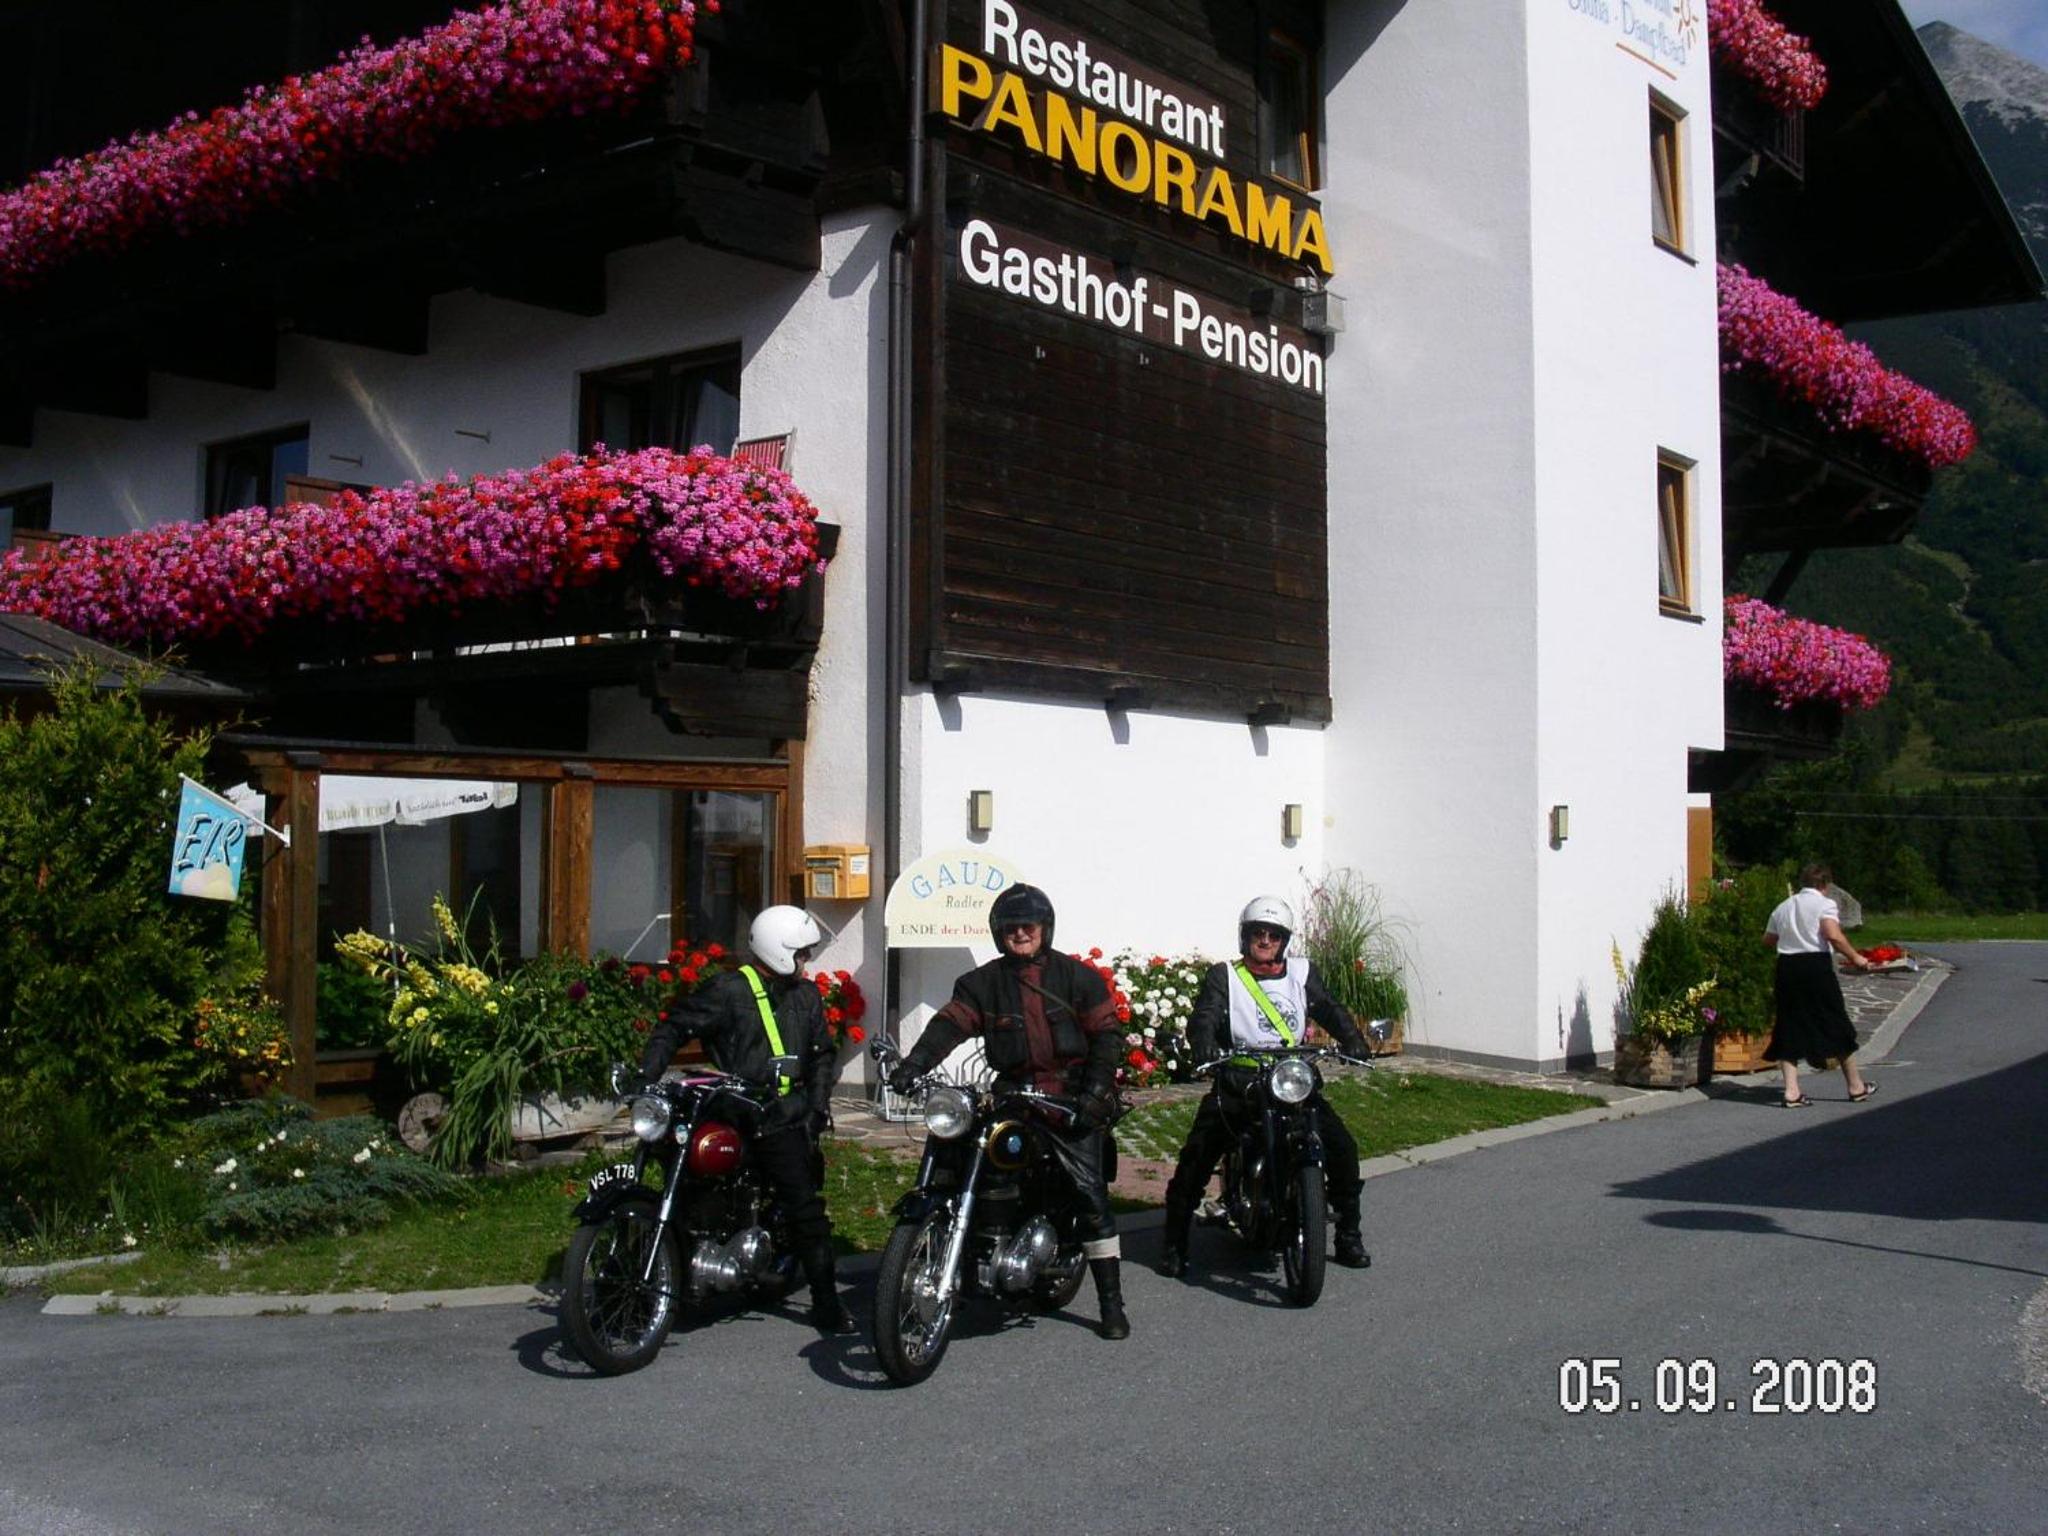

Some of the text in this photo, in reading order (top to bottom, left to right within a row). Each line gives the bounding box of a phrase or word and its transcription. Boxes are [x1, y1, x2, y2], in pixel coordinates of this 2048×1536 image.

[984, 0, 1226, 158] Restaurant
[942, 43, 1334, 277] PANORAMA
[945, 895, 984, 909] Radler
[900, 924, 938, 935] ENDE
[941, 924, 959, 935] der
[590, 1164, 636, 1191] VSL 778
